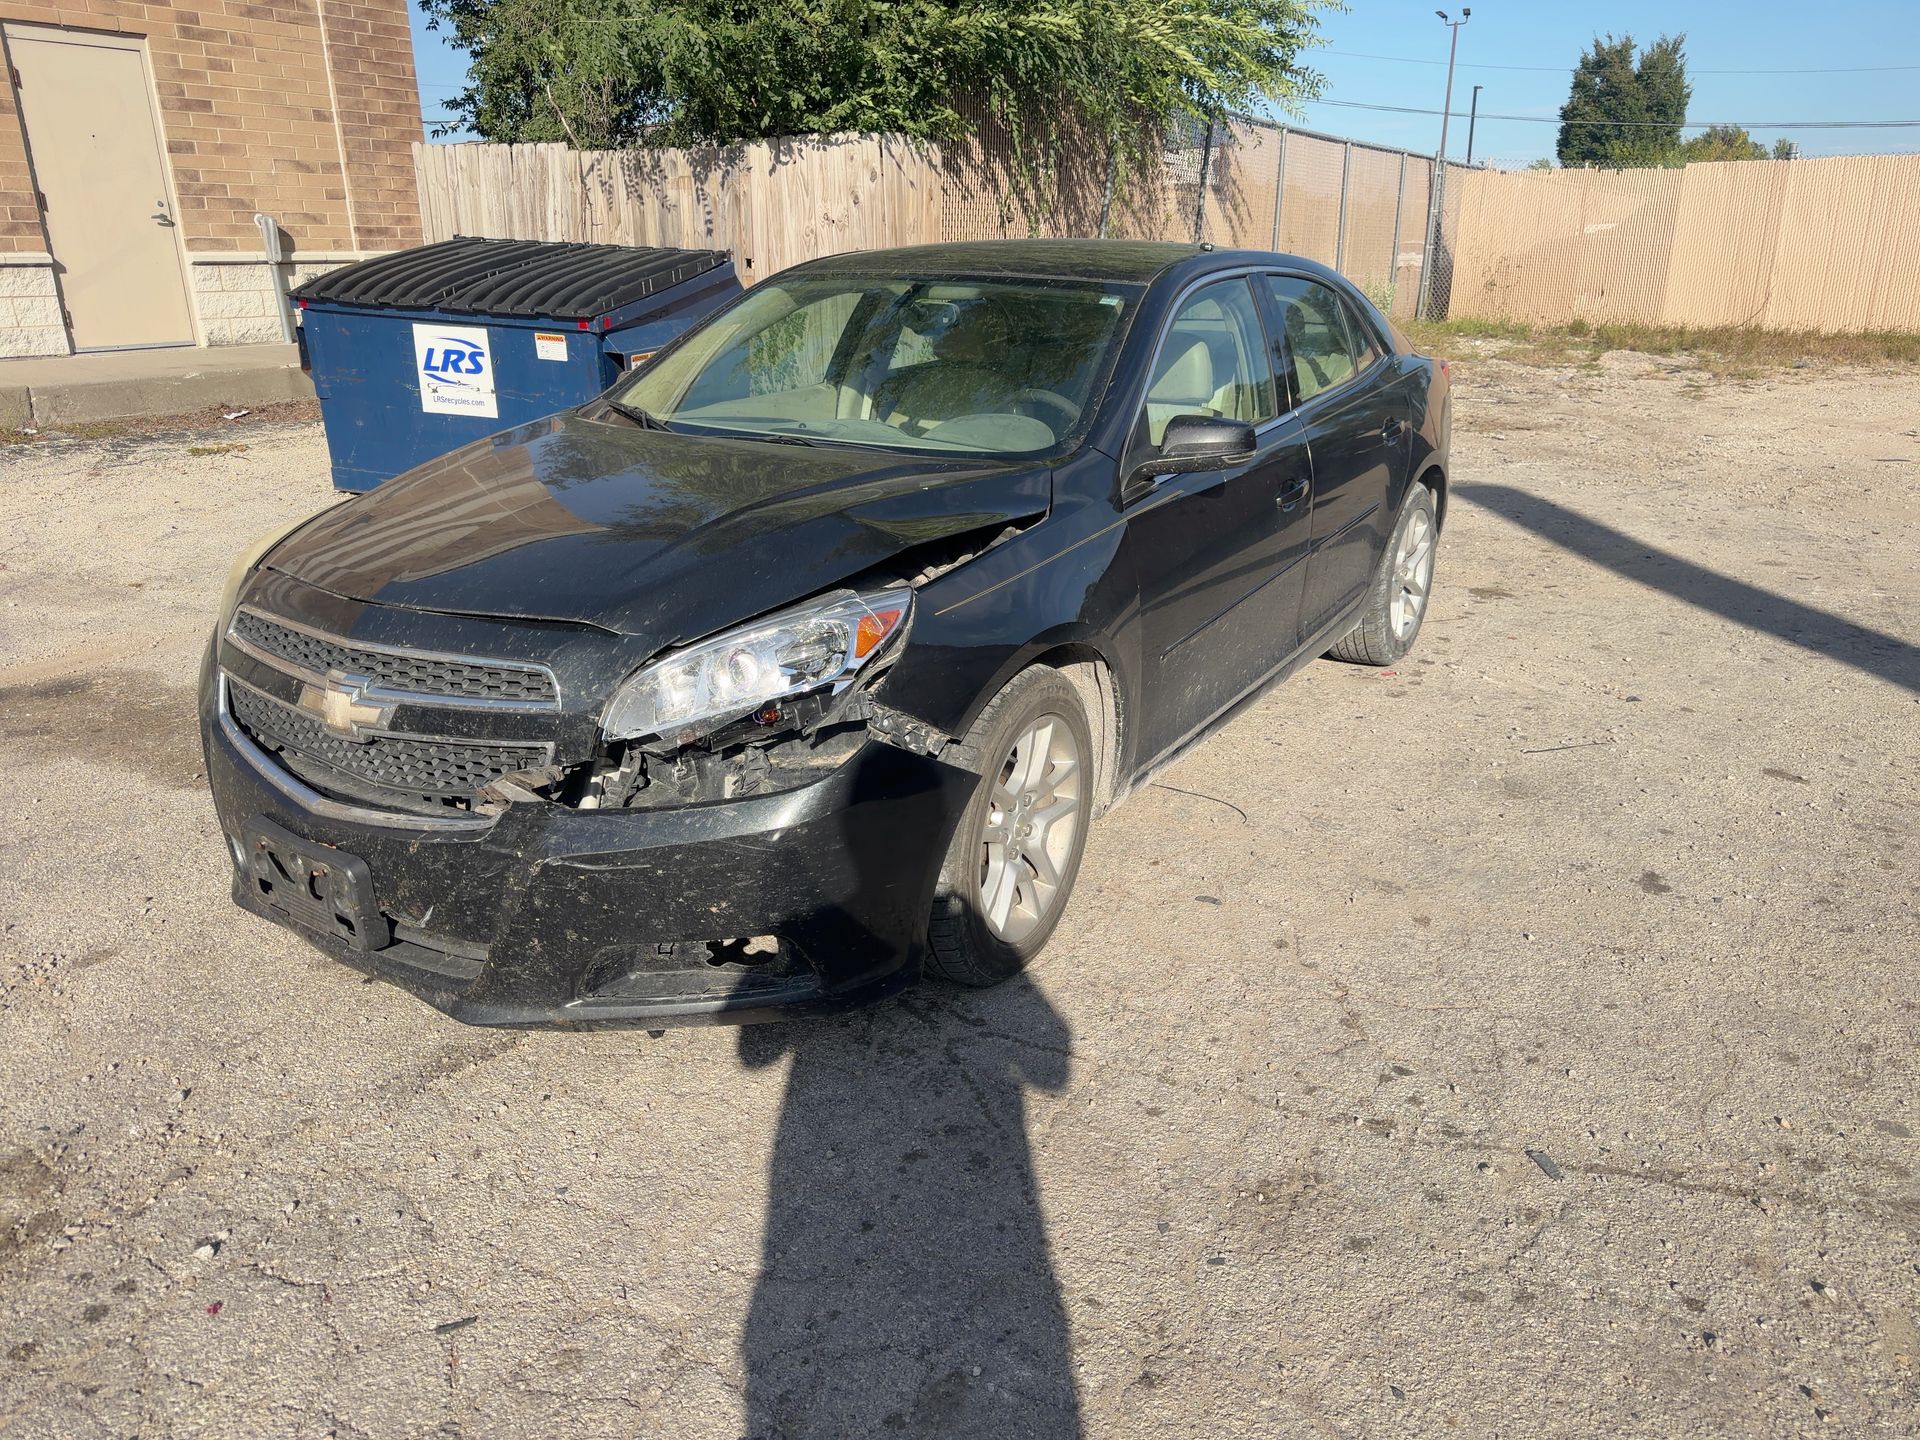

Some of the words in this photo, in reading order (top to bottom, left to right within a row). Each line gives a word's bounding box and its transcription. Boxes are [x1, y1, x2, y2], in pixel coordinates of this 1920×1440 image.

[541, 335, 562, 343] WARNING
[423, 347, 485, 375] LRS
[433, 395, 485, 407] LRSrecycles.com
